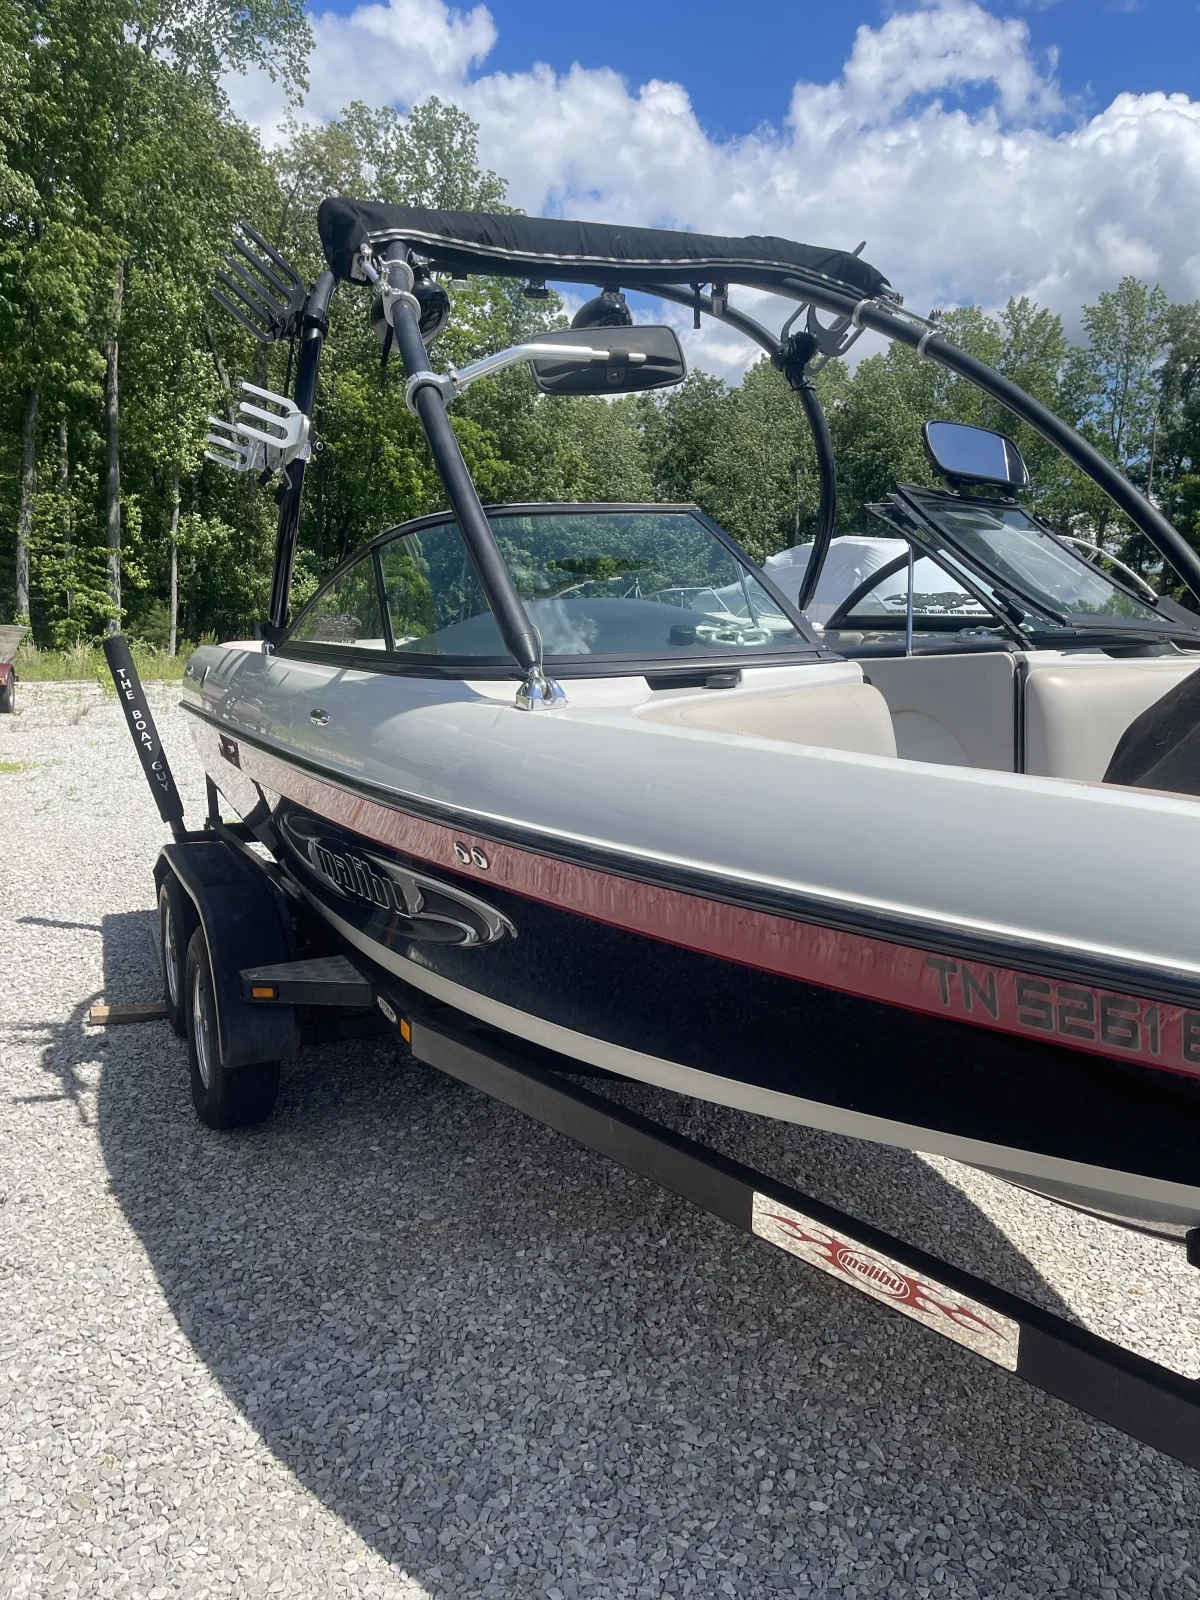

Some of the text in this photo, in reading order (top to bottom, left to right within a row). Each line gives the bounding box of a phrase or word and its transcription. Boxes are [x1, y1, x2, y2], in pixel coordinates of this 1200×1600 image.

[117, 668, 170, 792] THE BOAT GUY
[926, 956, 999, 1020] TN
[1014, 975, 1161, 1056] 5261
[840, 1253, 905, 1294] malibu
